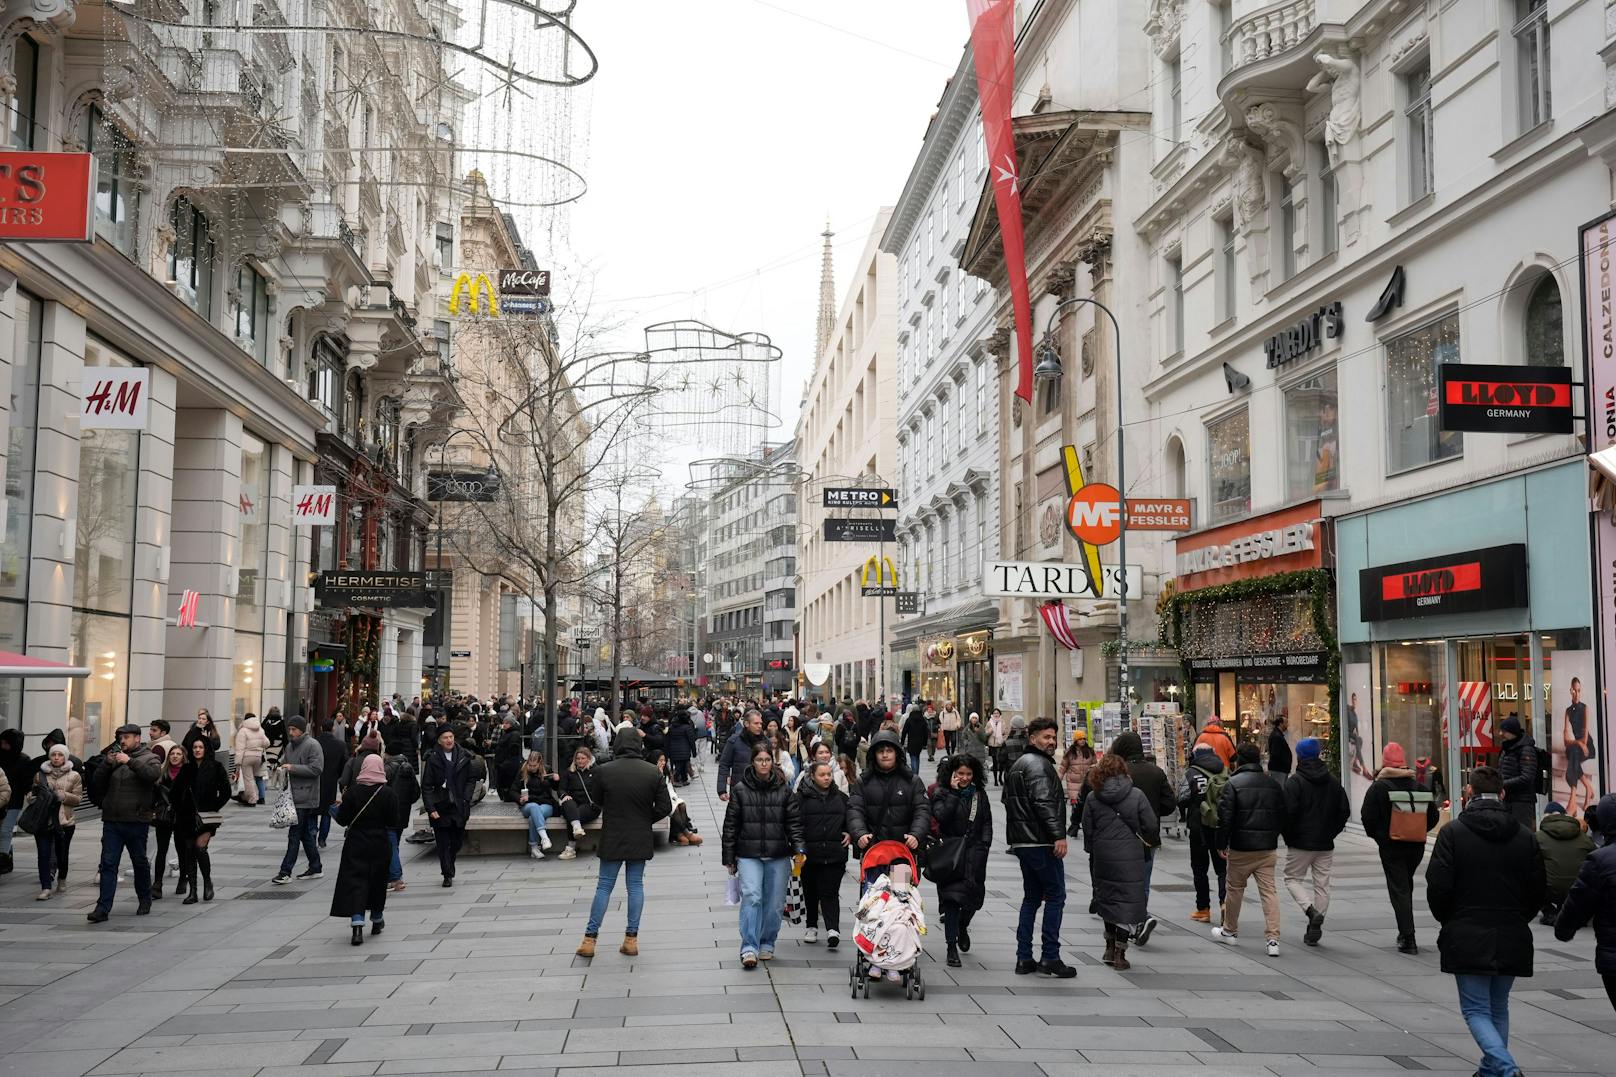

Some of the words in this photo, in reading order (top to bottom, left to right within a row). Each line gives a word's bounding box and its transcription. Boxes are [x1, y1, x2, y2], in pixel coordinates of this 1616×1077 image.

[502, 271, 546, 289] McCafé
[1599, 222, 1613, 359] CALZEDONIA
[85, 380, 142, 416] H&M
[1462, 384, 1556, 405] LLOYD
[1487, 409, 1531, 418] GERMANY
[297, 493, 332, 517] H&M
[827, 491, 878, 501] METRO
[1134, 504, 1172, 513] MAYR
[1176, 505, 1184, 513] &
[1130, 516, 1189, 525] FESSLER
[325, 576, 421, 587] HERMETISE
[993, 565, 1129, 596] TARD'S
[1403, 569, 1455, 597] LLOYD
[1416, 596, 1441, 606] GERMANY
